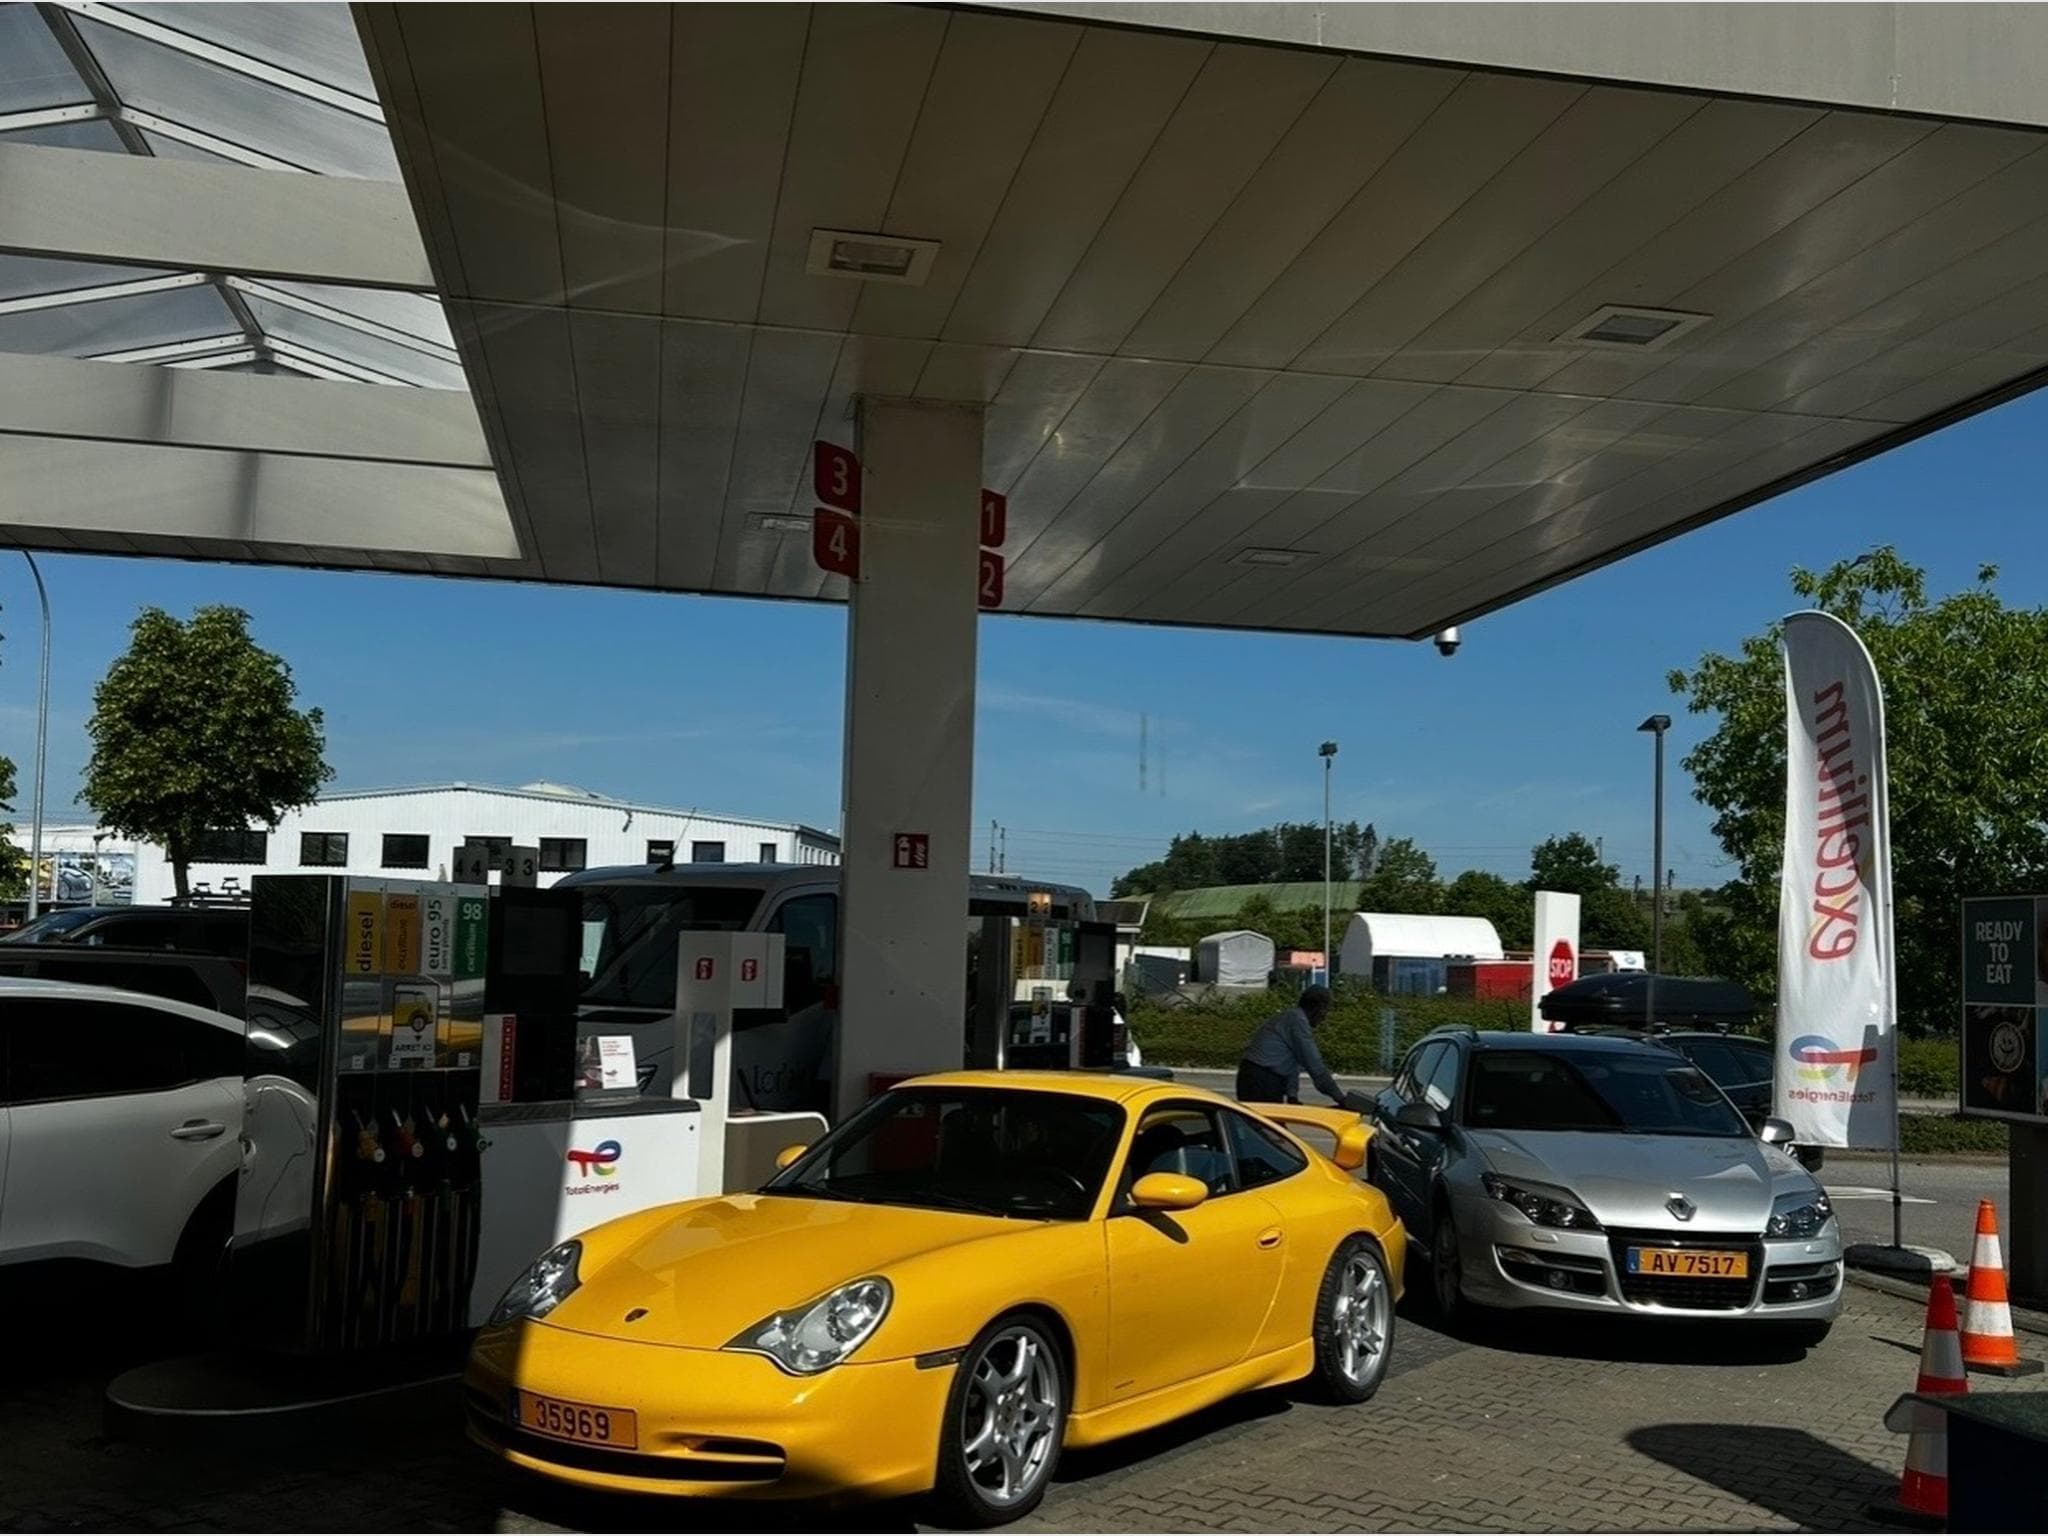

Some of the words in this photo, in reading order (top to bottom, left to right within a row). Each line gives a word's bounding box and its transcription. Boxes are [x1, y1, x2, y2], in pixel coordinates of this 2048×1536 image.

[831, 456, 848, 496] 3
[985, 501, 995, 536] 1
[829, 525, 848, 562] 4
[981, 561, 996, 599] 2
[471, 859, 481, 876] 4
[504, 858, 514, 876] 3
[523, 859, 534, 876] 3
[428, 900, 442, 922] 95
[463, 903, 482, 920] 98
[356, 911, 374, 972] diesel
[1975, 921, 2024, 942] READY
[428, 929, 441, 970] euro
[1989, 943, 2010, 963] TO
[1550, 958, 1572, 979] STOP
[1986, 963, 2012, 984] EAT
[1652, 1253, 1679, 1273] AV
[1684, 1256, 1735, 1275] 7517
[535, 1400, 610, 1440] 35969
